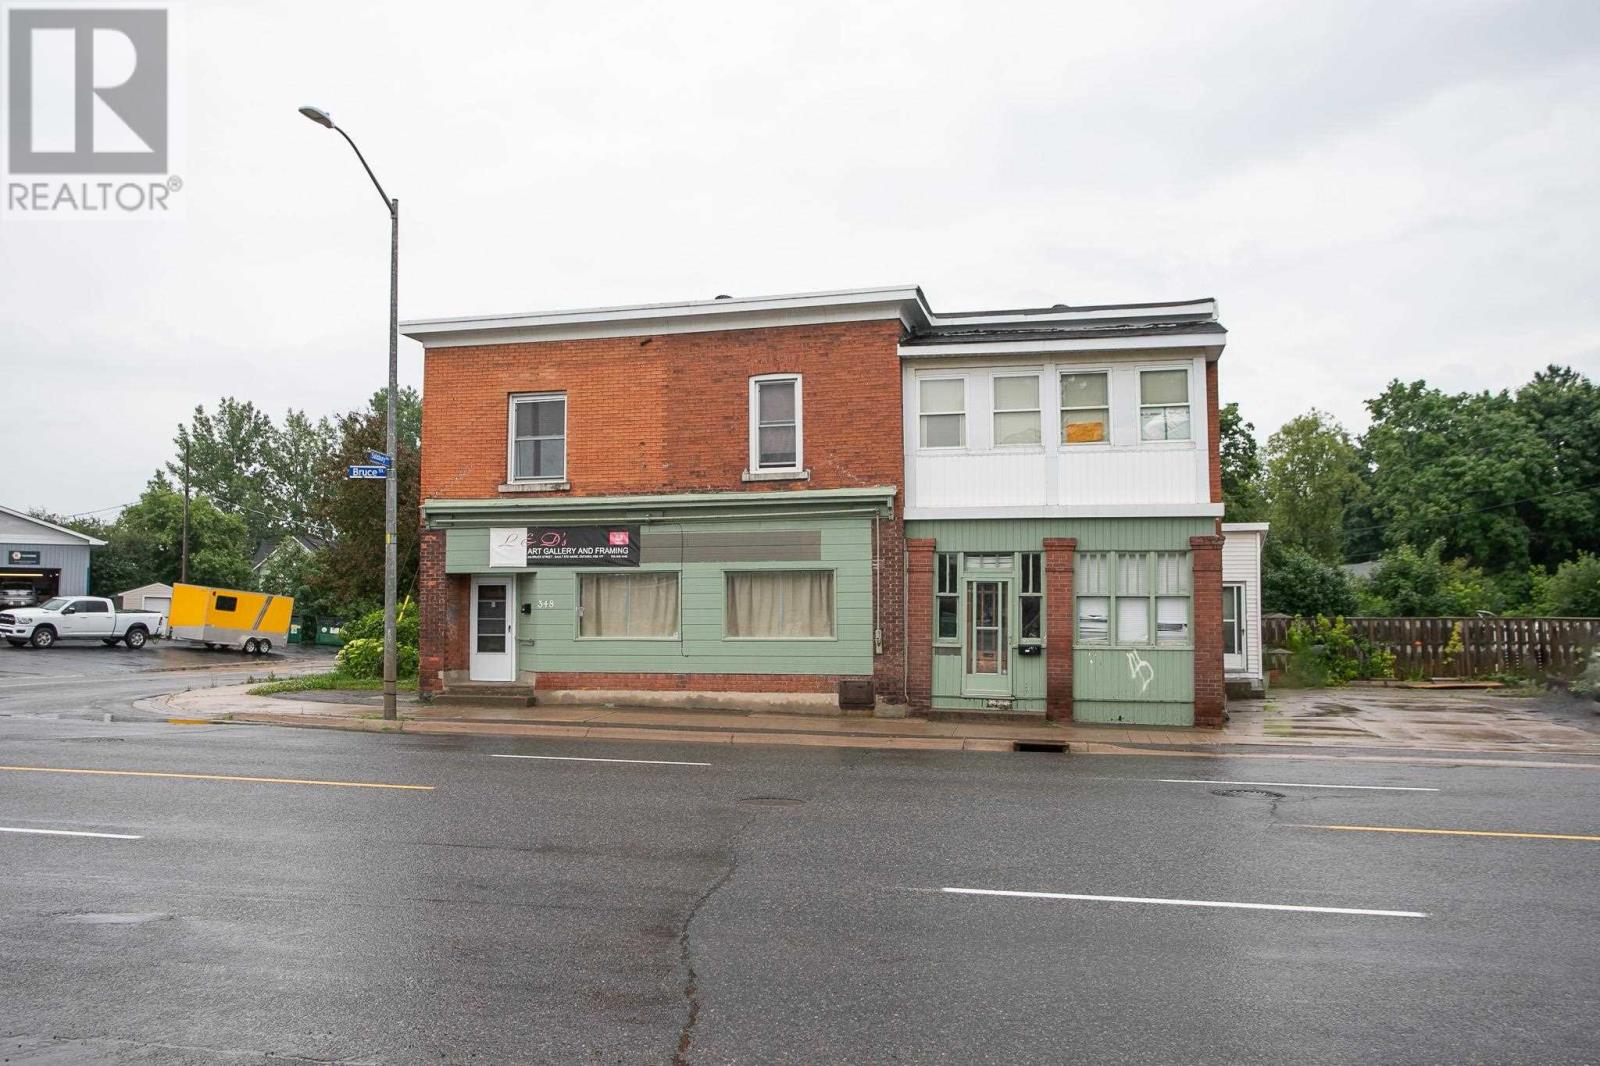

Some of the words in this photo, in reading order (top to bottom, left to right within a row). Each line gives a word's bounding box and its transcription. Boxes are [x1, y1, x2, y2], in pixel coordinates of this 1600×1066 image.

[352, 468, 378, 476] Bruce
[527, 547, 542, 555] ART
[543, 547, 577, 555] GALLERY
[595, 546, 629, 554] FRAMING
[537, 600, 554, 608] 348
